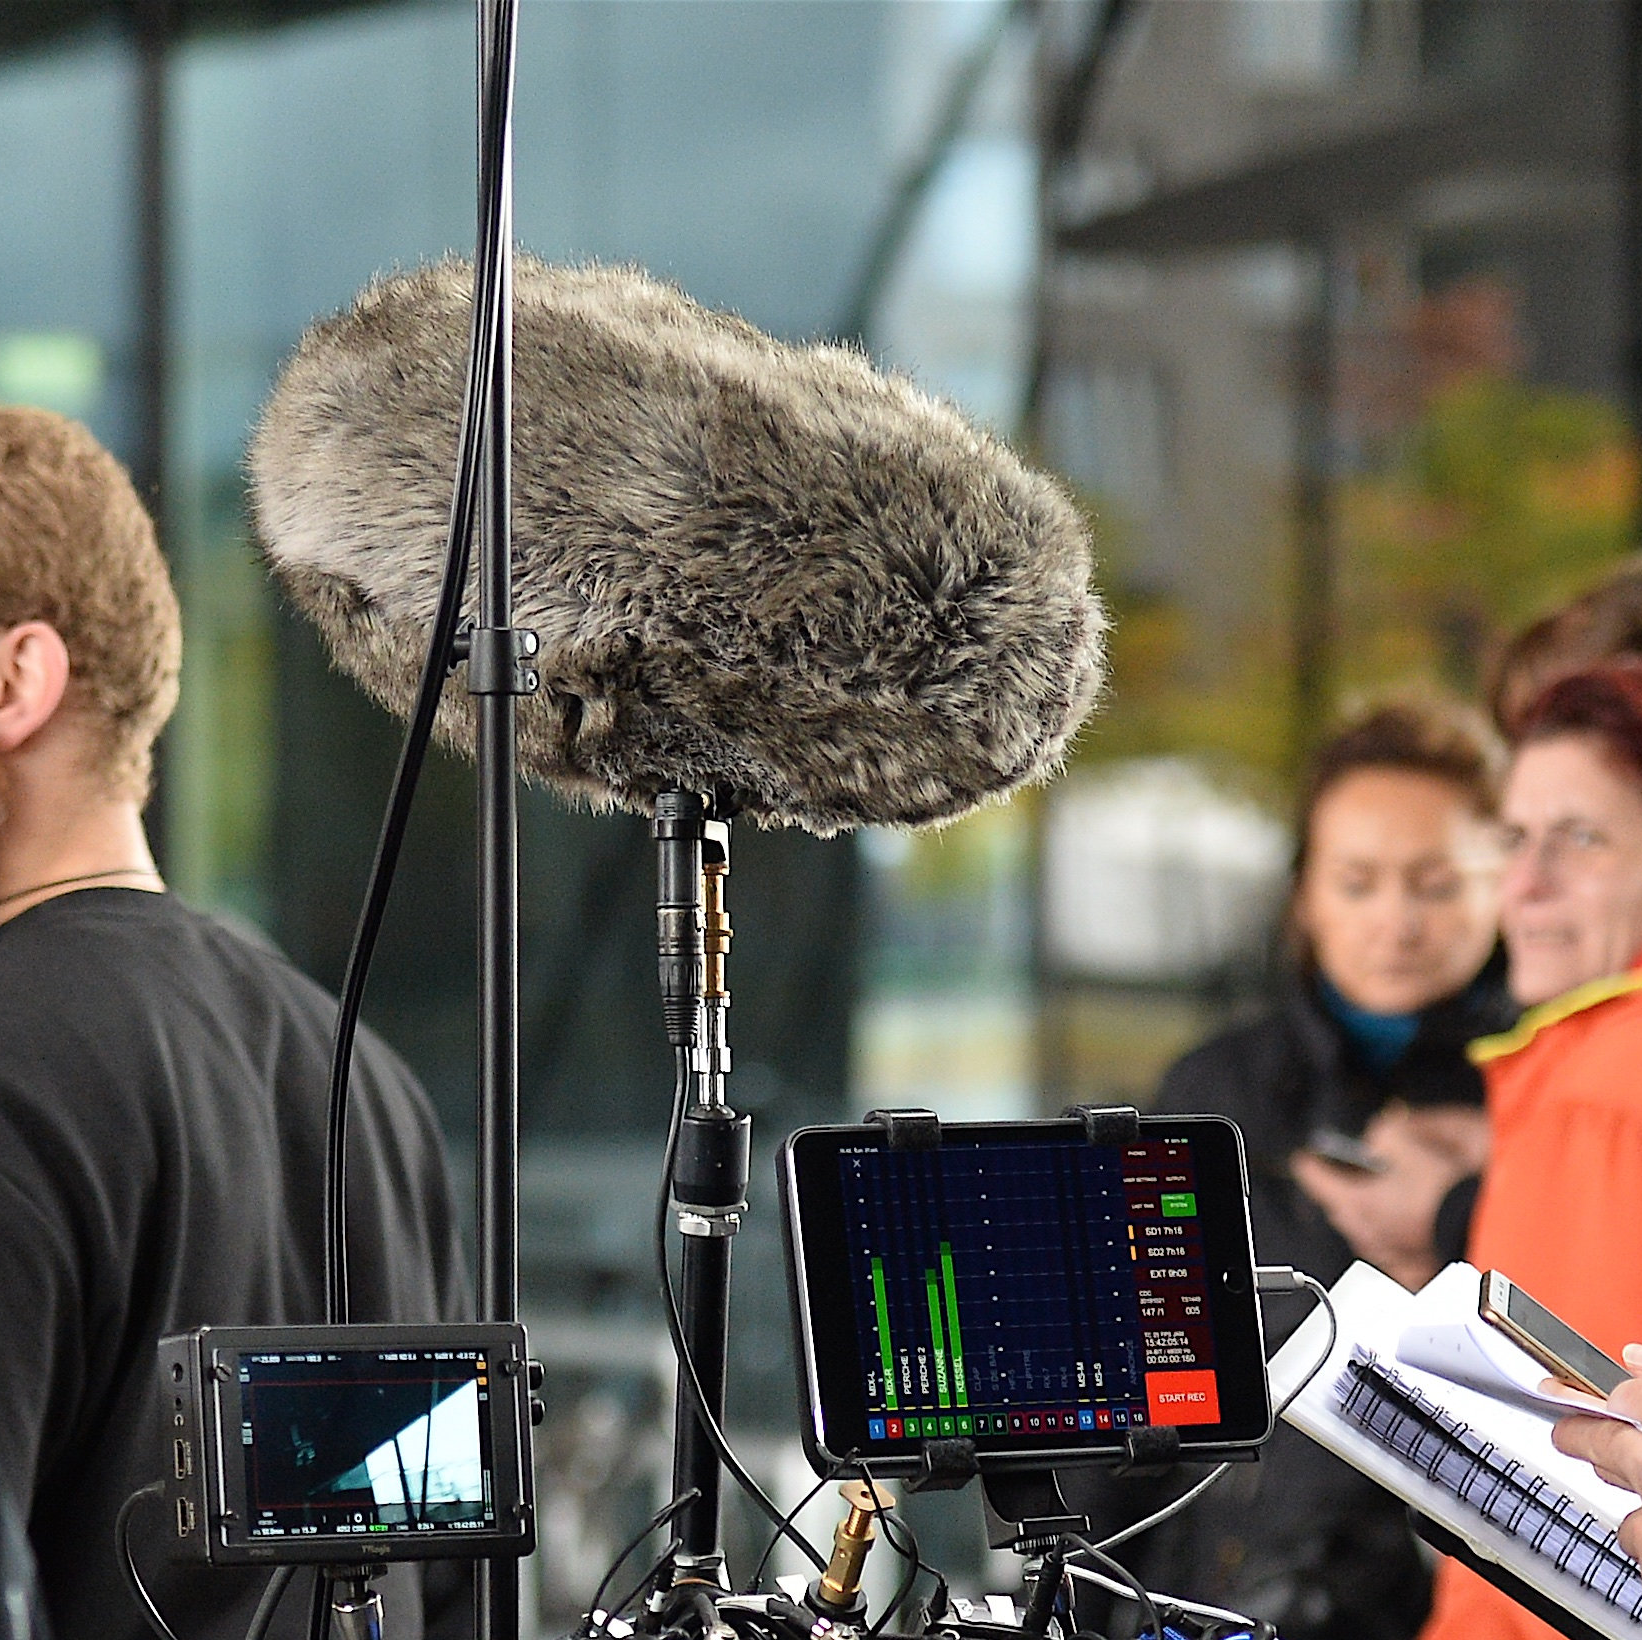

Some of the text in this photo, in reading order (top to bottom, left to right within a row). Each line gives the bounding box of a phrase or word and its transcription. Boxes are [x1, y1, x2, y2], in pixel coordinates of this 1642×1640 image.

[1145, 1226, 1162, 1236] SD1
[1147, 1248, 1165, 1257] SD2
[1149, 1269, 1167, 1279] EXT
[900, 1355, 912, 1395] PERCHE
[918, 1355, 930, 1394] PERCHE
[934, 1348, 947, 1393] SUZANNE
[1159, 1392, 1206, 1403] START REC
[874, 1425, 880, 1433] 1
[891, 1424, 898, 1433] 2
[909, 1423, 915, 1432] 3
[926, 1422, 933, 1431] 4
[944, 1421, 951, 1430] 5
[961, 1421, 968, 1430] 6
[979, 1419, 985, 1429] 7
[996, 1419, 1003, 1428] 8
[1013, 1418, 1020, 1428] 9
[1029, 1417, 1040, 1427] 10
[1047, 1417, 1056, 1426] 11
[1064, 1416, 1074, 1425] 12
[1082, 1415, 1092, 1425] 13
[1098, 1414, 1109, 1424] 14
[1116, 1414, 1126, 1423] 15
